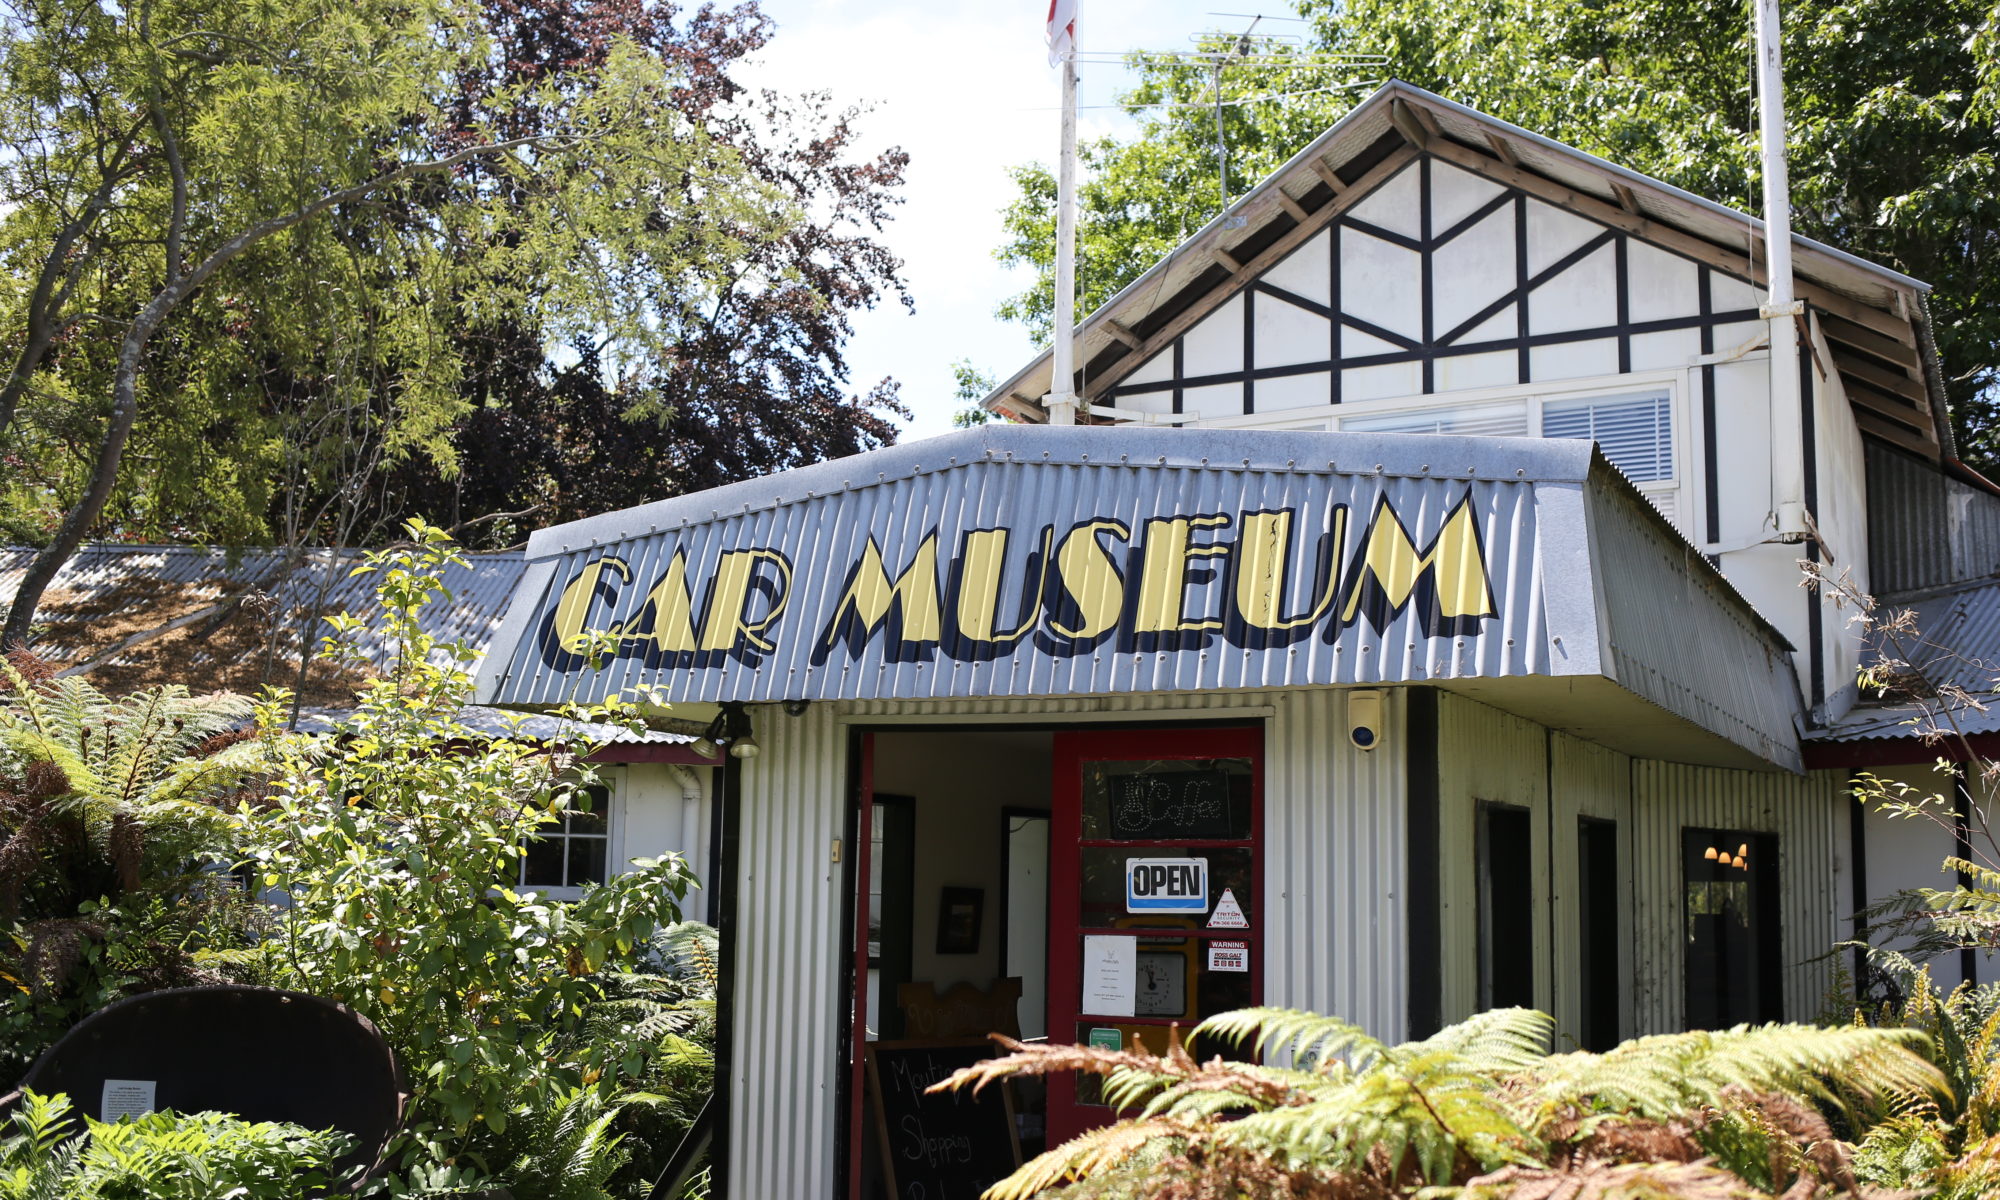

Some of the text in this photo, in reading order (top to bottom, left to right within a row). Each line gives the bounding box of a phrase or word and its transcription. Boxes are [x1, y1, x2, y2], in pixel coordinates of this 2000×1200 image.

[539, 483, 1500, 675] CAR MUSEUM
[1146, 780, 1222, 826] Coffee
[1133, 864, 1200, 897] OPEN
[1211, 941, 1245, 949] WARNING
[901, 1113, 972, 1169] Shopping
